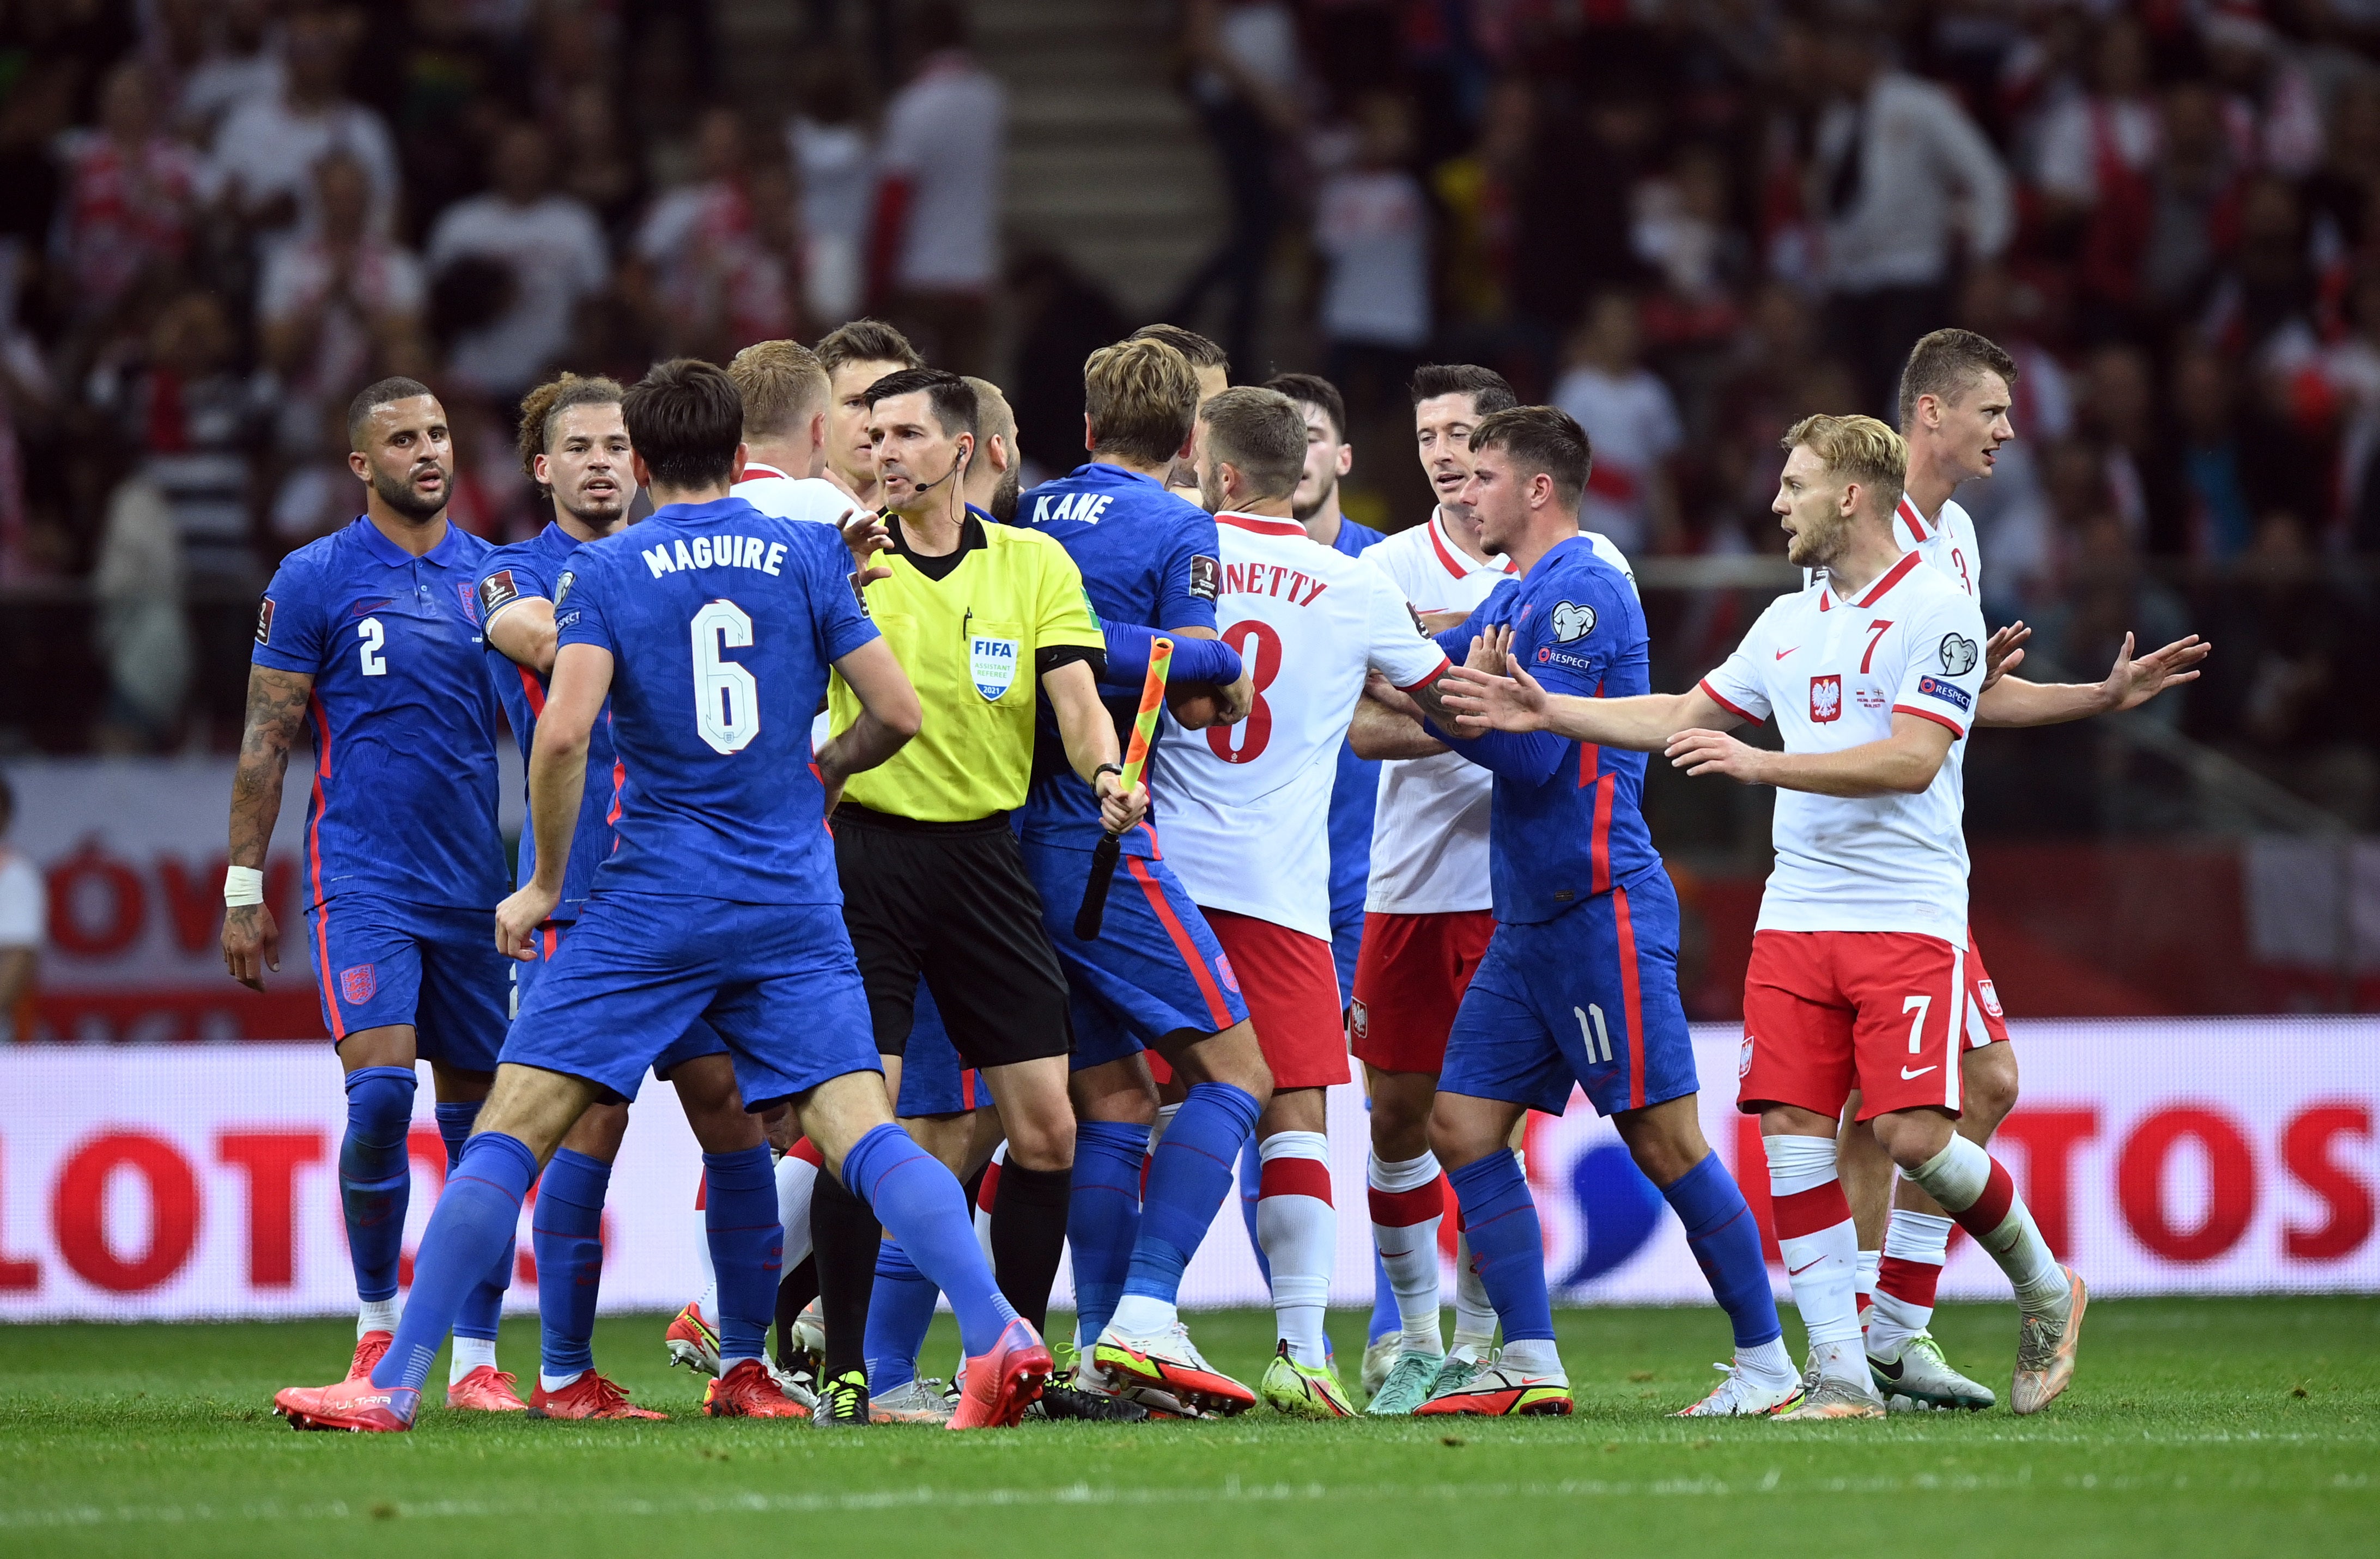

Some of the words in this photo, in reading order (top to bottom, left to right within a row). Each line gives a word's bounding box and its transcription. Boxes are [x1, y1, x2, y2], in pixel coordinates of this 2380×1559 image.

[1032, 493, 1114, 525] KANE
[642, 535, 788, 578] MAGUIRE
[357, 617, 386, 675] 2
[975, 641, 1012, 658] FIFA
[1860, 619, 1895, 674] 7
[1550, 652, 1590, 669] RESPECT
[690, 599, 760, 754] 6
[977, 670, 1007, 679] REFEREE
[982, 686, 1000, 695] 2021
[1935, 685, 1970, 707] RESPECT
[1574, 1003, 1613, 1064] 11
[1902, 995, 1932, 1053] 7
[687, 1317, 705, 1336] TIEMPO
[336, 1396, 391, 1410] ULTRA
